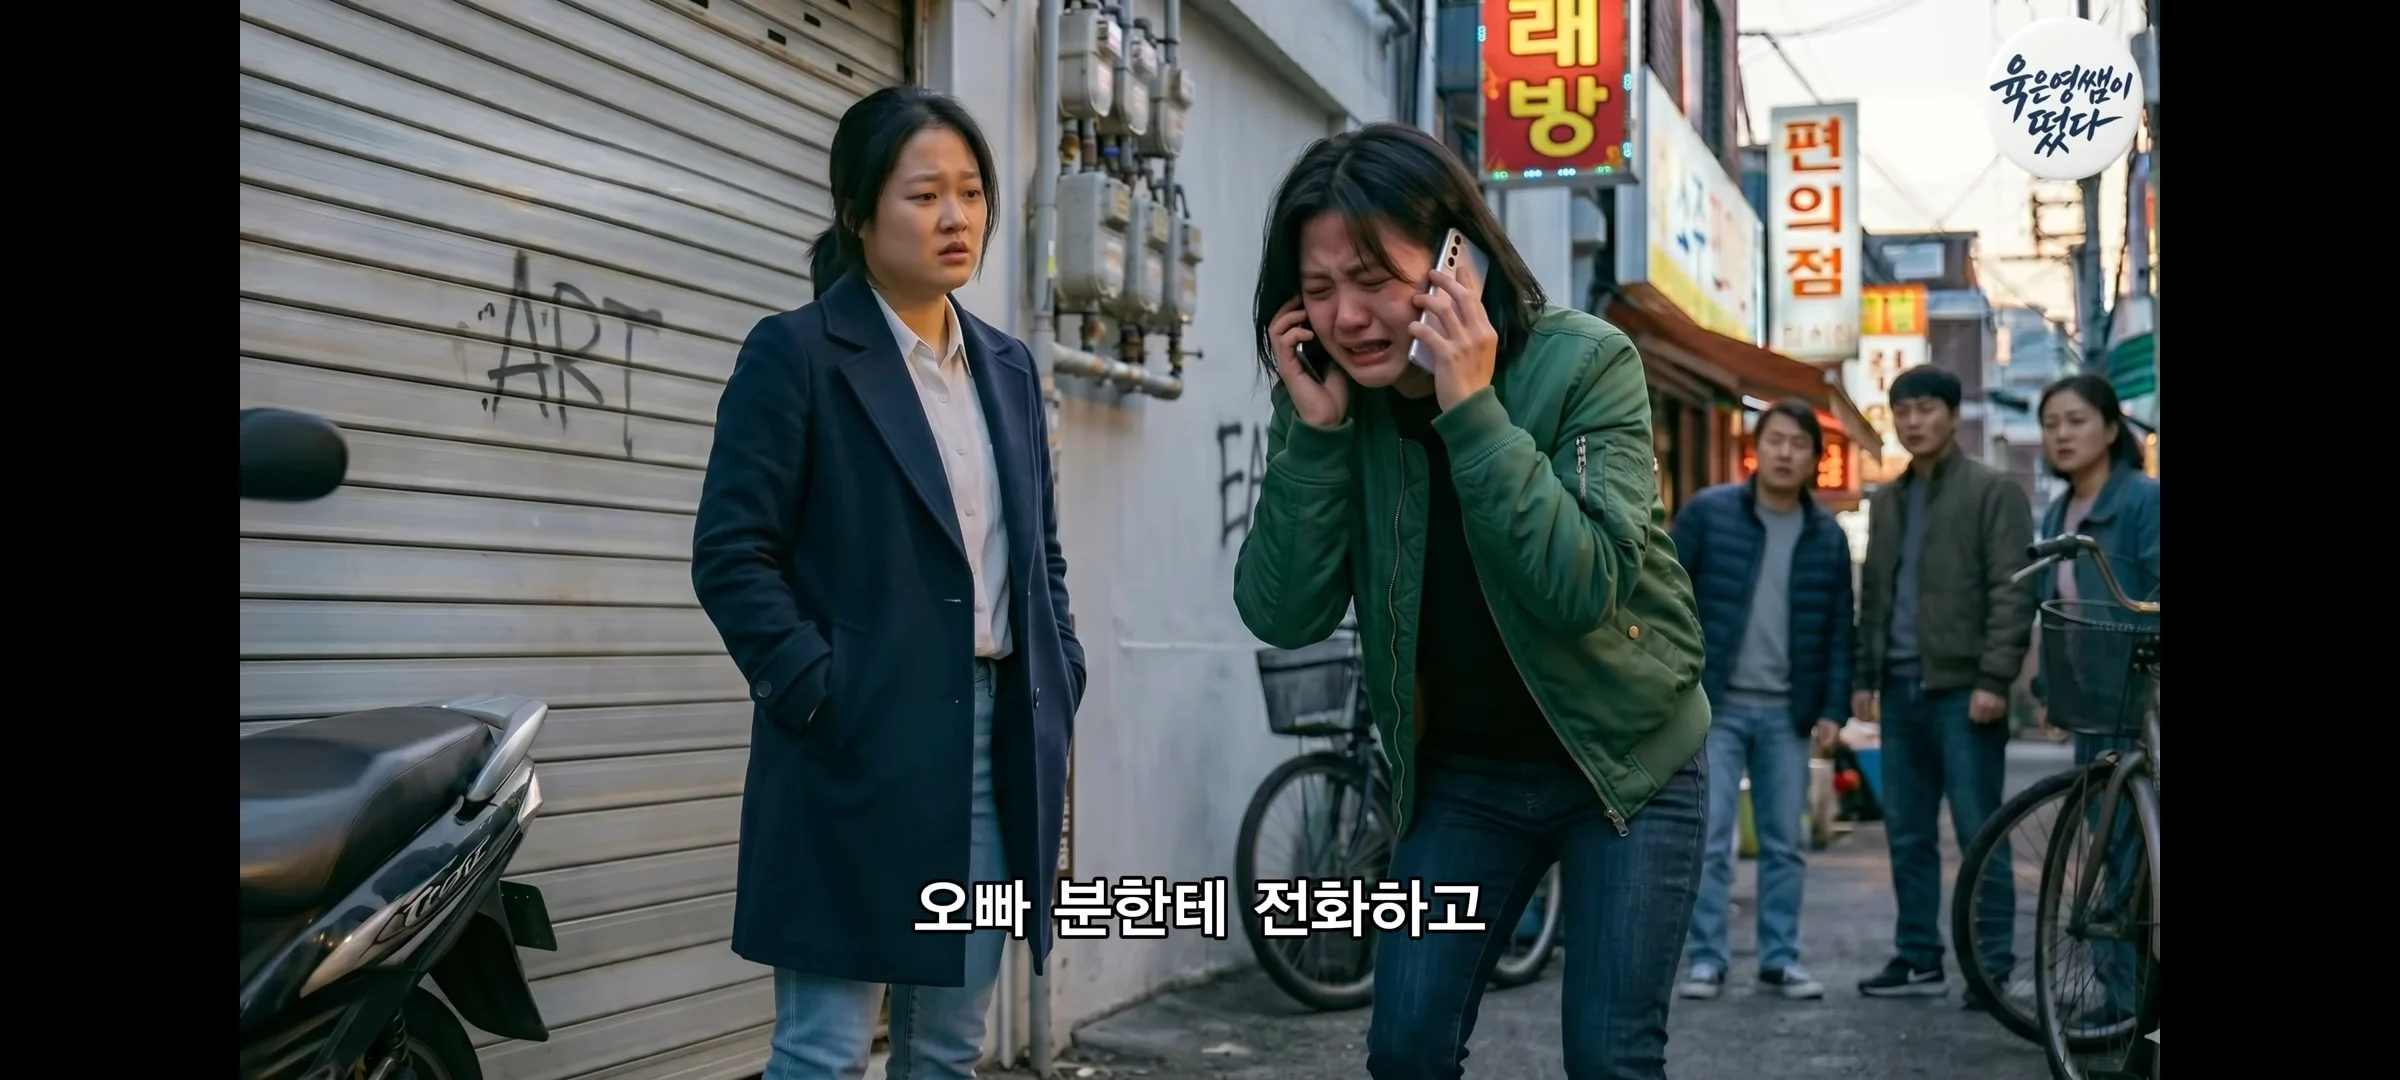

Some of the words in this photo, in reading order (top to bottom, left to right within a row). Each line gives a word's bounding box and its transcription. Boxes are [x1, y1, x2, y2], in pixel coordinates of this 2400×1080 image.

[1508, 0, 1609, 158] 래방
[1786, 116, 1842, 298] 편의점
[487, 250, 663, 458] ART
